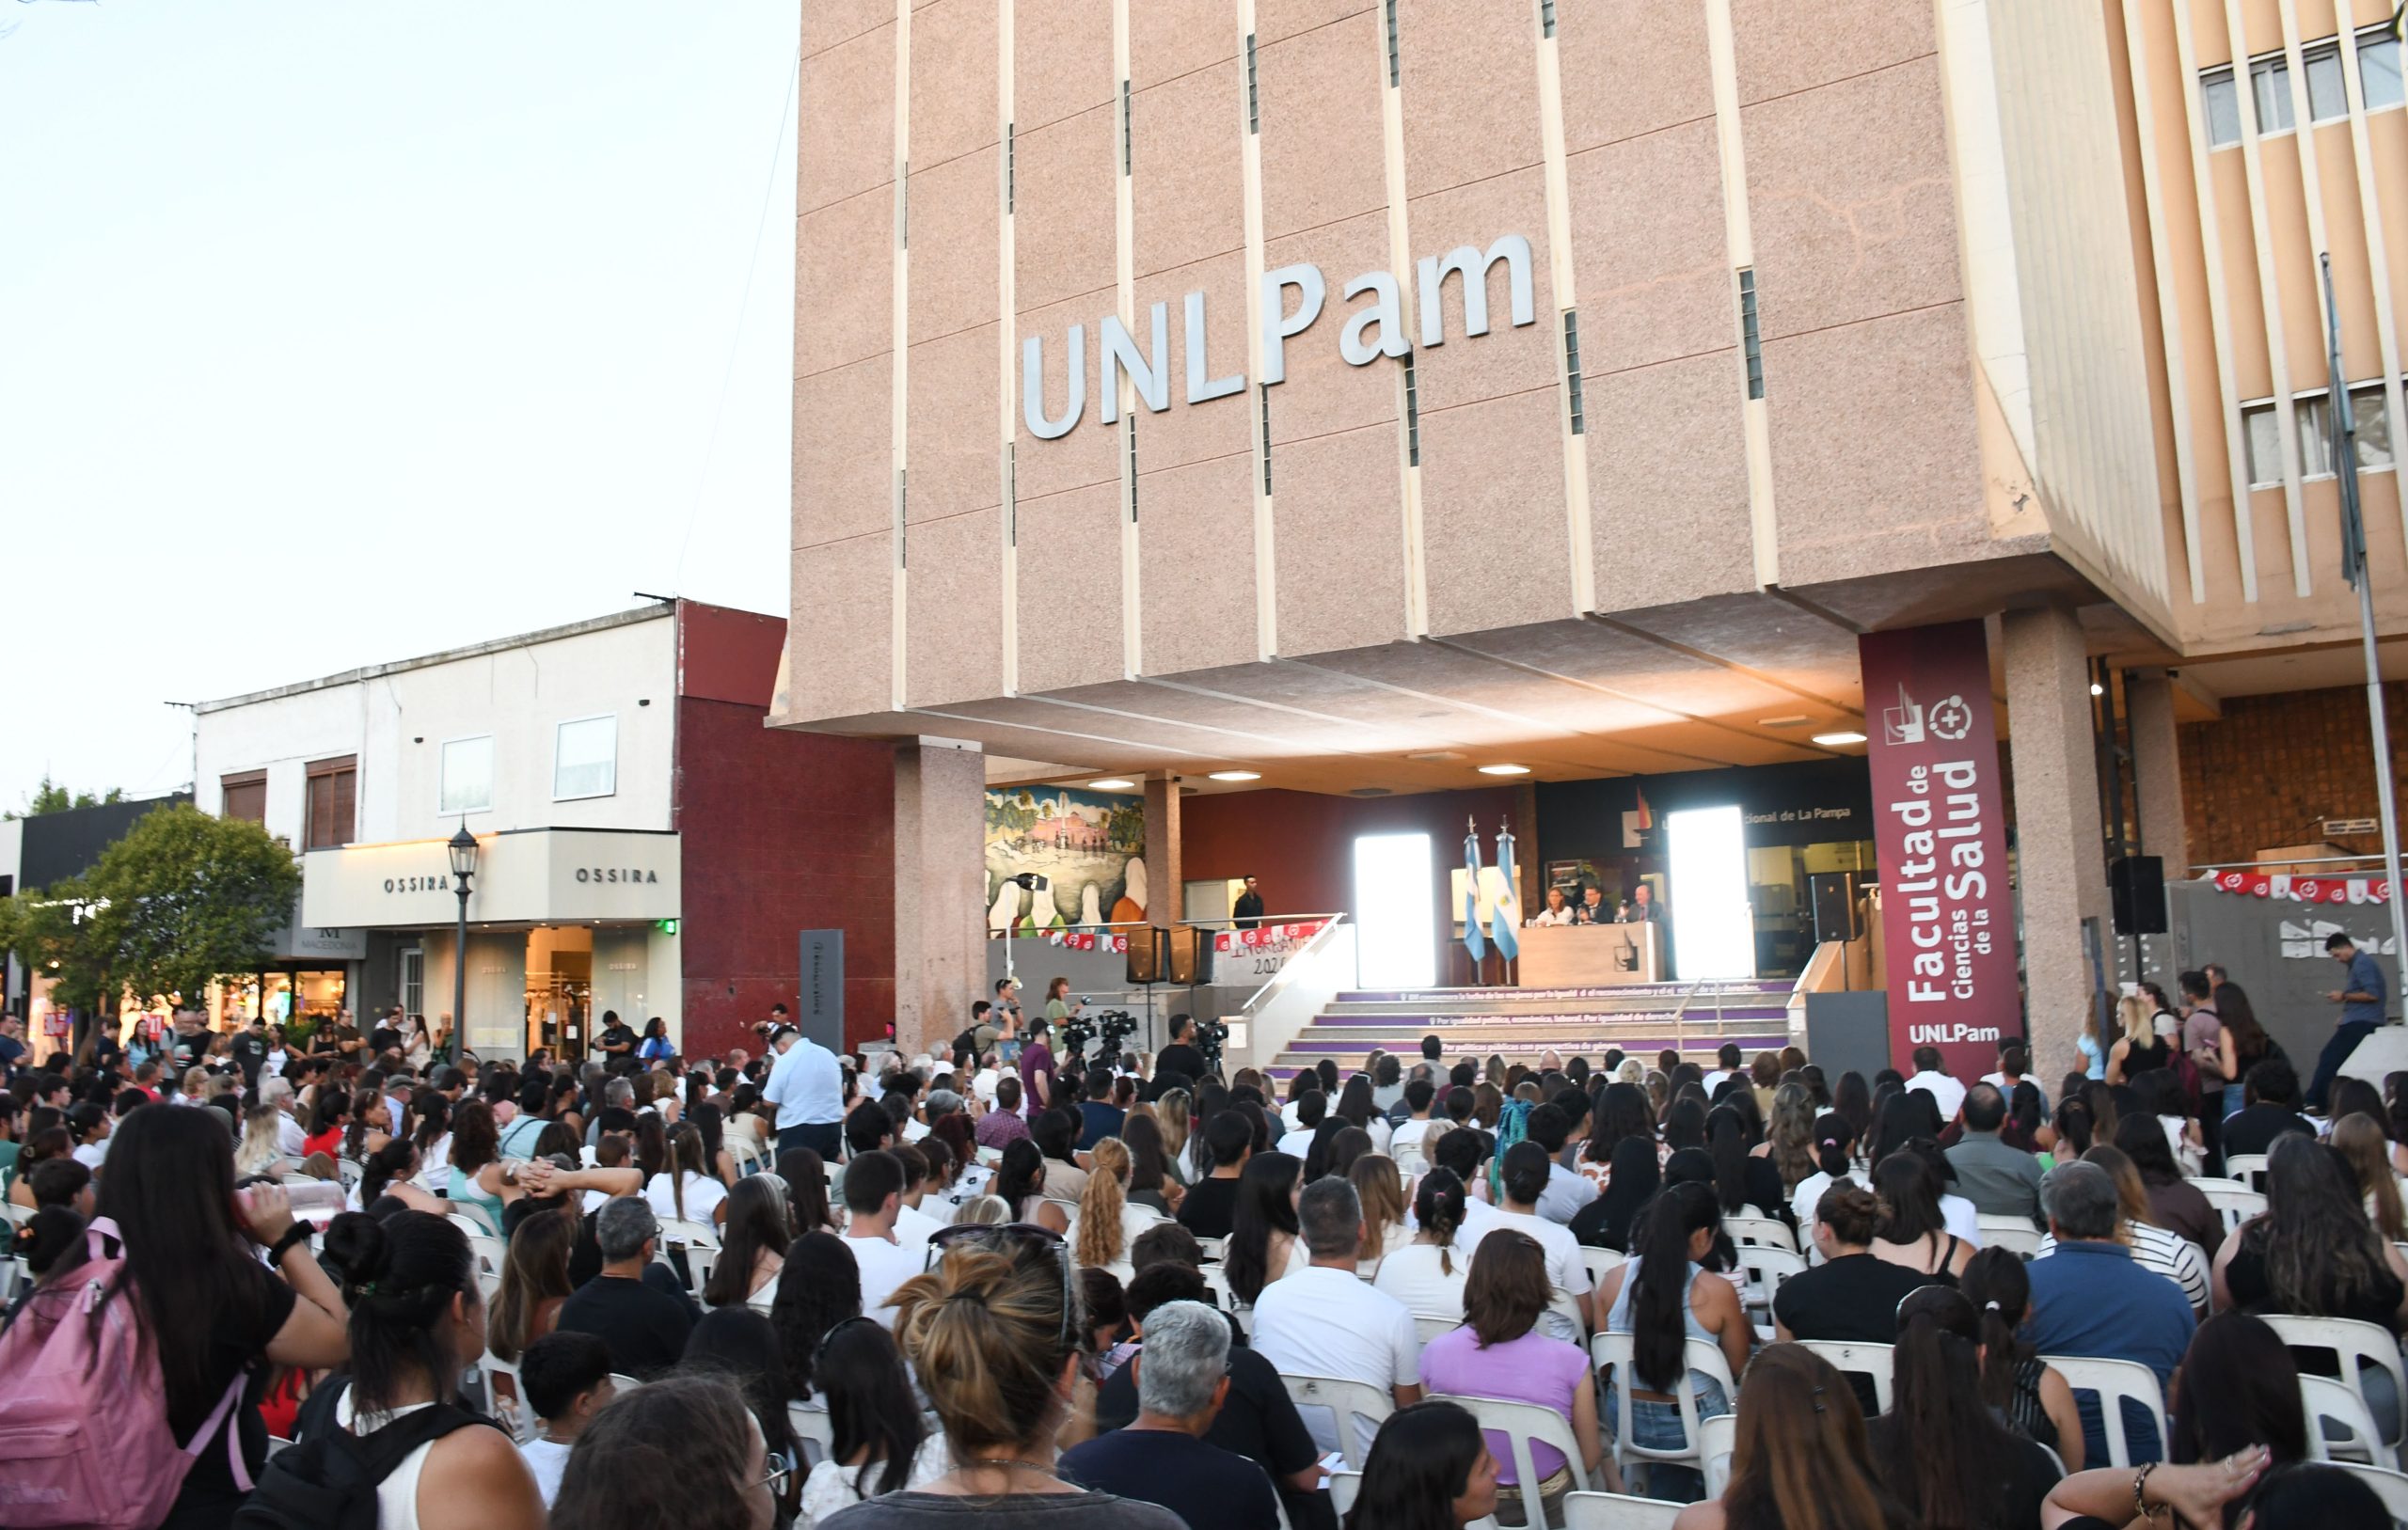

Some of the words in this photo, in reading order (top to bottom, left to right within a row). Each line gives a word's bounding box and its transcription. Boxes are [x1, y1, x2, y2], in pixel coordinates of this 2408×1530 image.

[1022, 234, 1536, 439] UNLPam
[1907, 765, 1929, 795] de
[1745, 812, 1777, 825] cional
[1781, 810, 1795, 822] de
[1798, 809, 1812, 821] La
[1814, 807, 1851, 821] Pampa
[1932, 760, 1988, 901] Salud
[384, 875, 449, 893] OSSIRA
[576, 868, 657, 884] OSSIRA
[1891, 800, 1946, 1002] Facultad
[1972, 908, 1989, 925] la
[1973, 931, 1991, 954] de
[1947, 909, 1974, 1000] Ciencias
[1909, 1023, 2000, 1044] UNLPam
